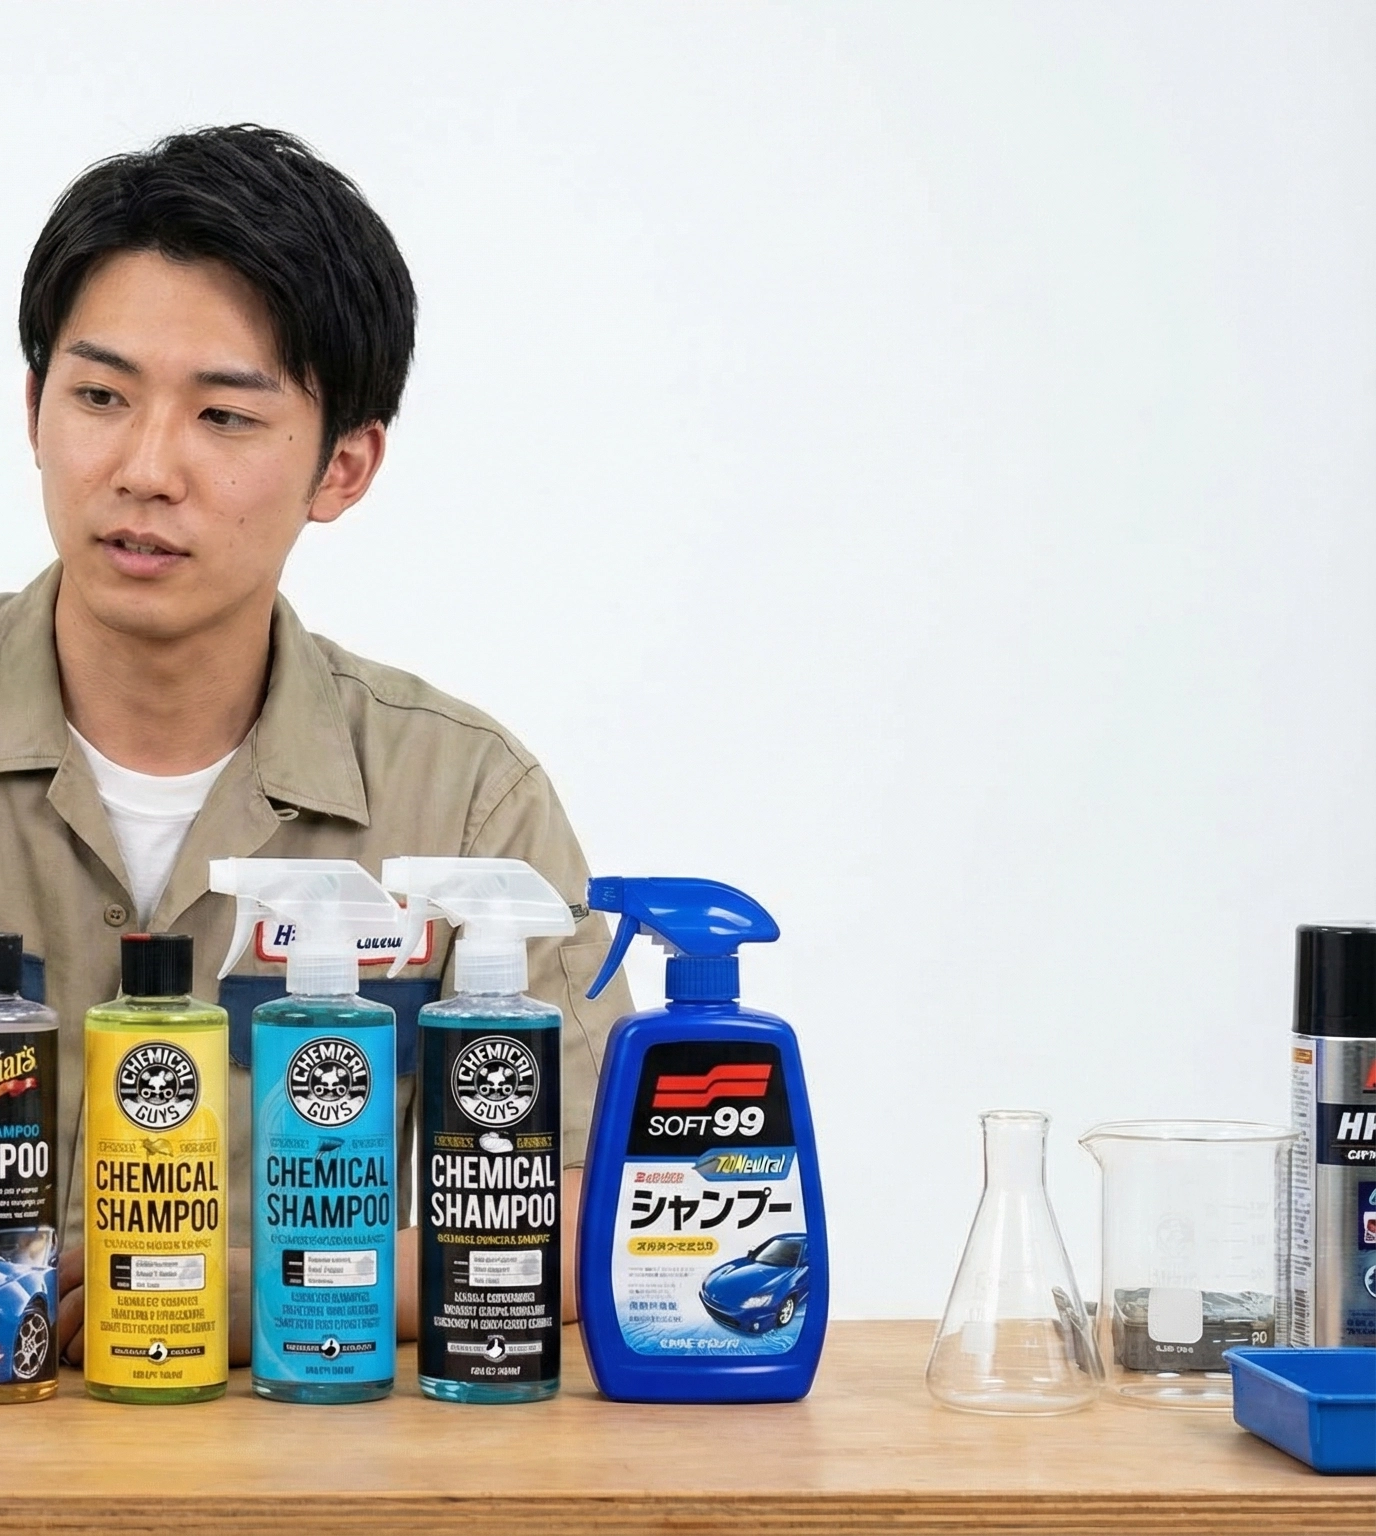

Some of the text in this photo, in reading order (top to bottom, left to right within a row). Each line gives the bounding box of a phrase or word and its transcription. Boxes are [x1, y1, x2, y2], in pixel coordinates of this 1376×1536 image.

[121, 1047, 194, 1086] CHEMICAL
[292, 1043, 367, 1083] CHEMICAL
[458, 1043, 533, 1082] CHEMICAL
[135, 1105, 180, 1124] GUYS
[306, 1101, 353, 1121] GUYS
[473, 1100, 519, 1120] GUYS
[96, 1159, 219, 1194] CHEMICAL
[266, 1155, 389, 1189] CHEMICAL
[431, 1154, 556, 1190] CHEMICAL
[96, 1197, 219, 1233] SHAMPOO
[266, 1192, 390, 1229] SHAMPOO
[430, 1192, 556, 1229] SHAMPOO
[629, 1186, 793, 1231] シャンプー
